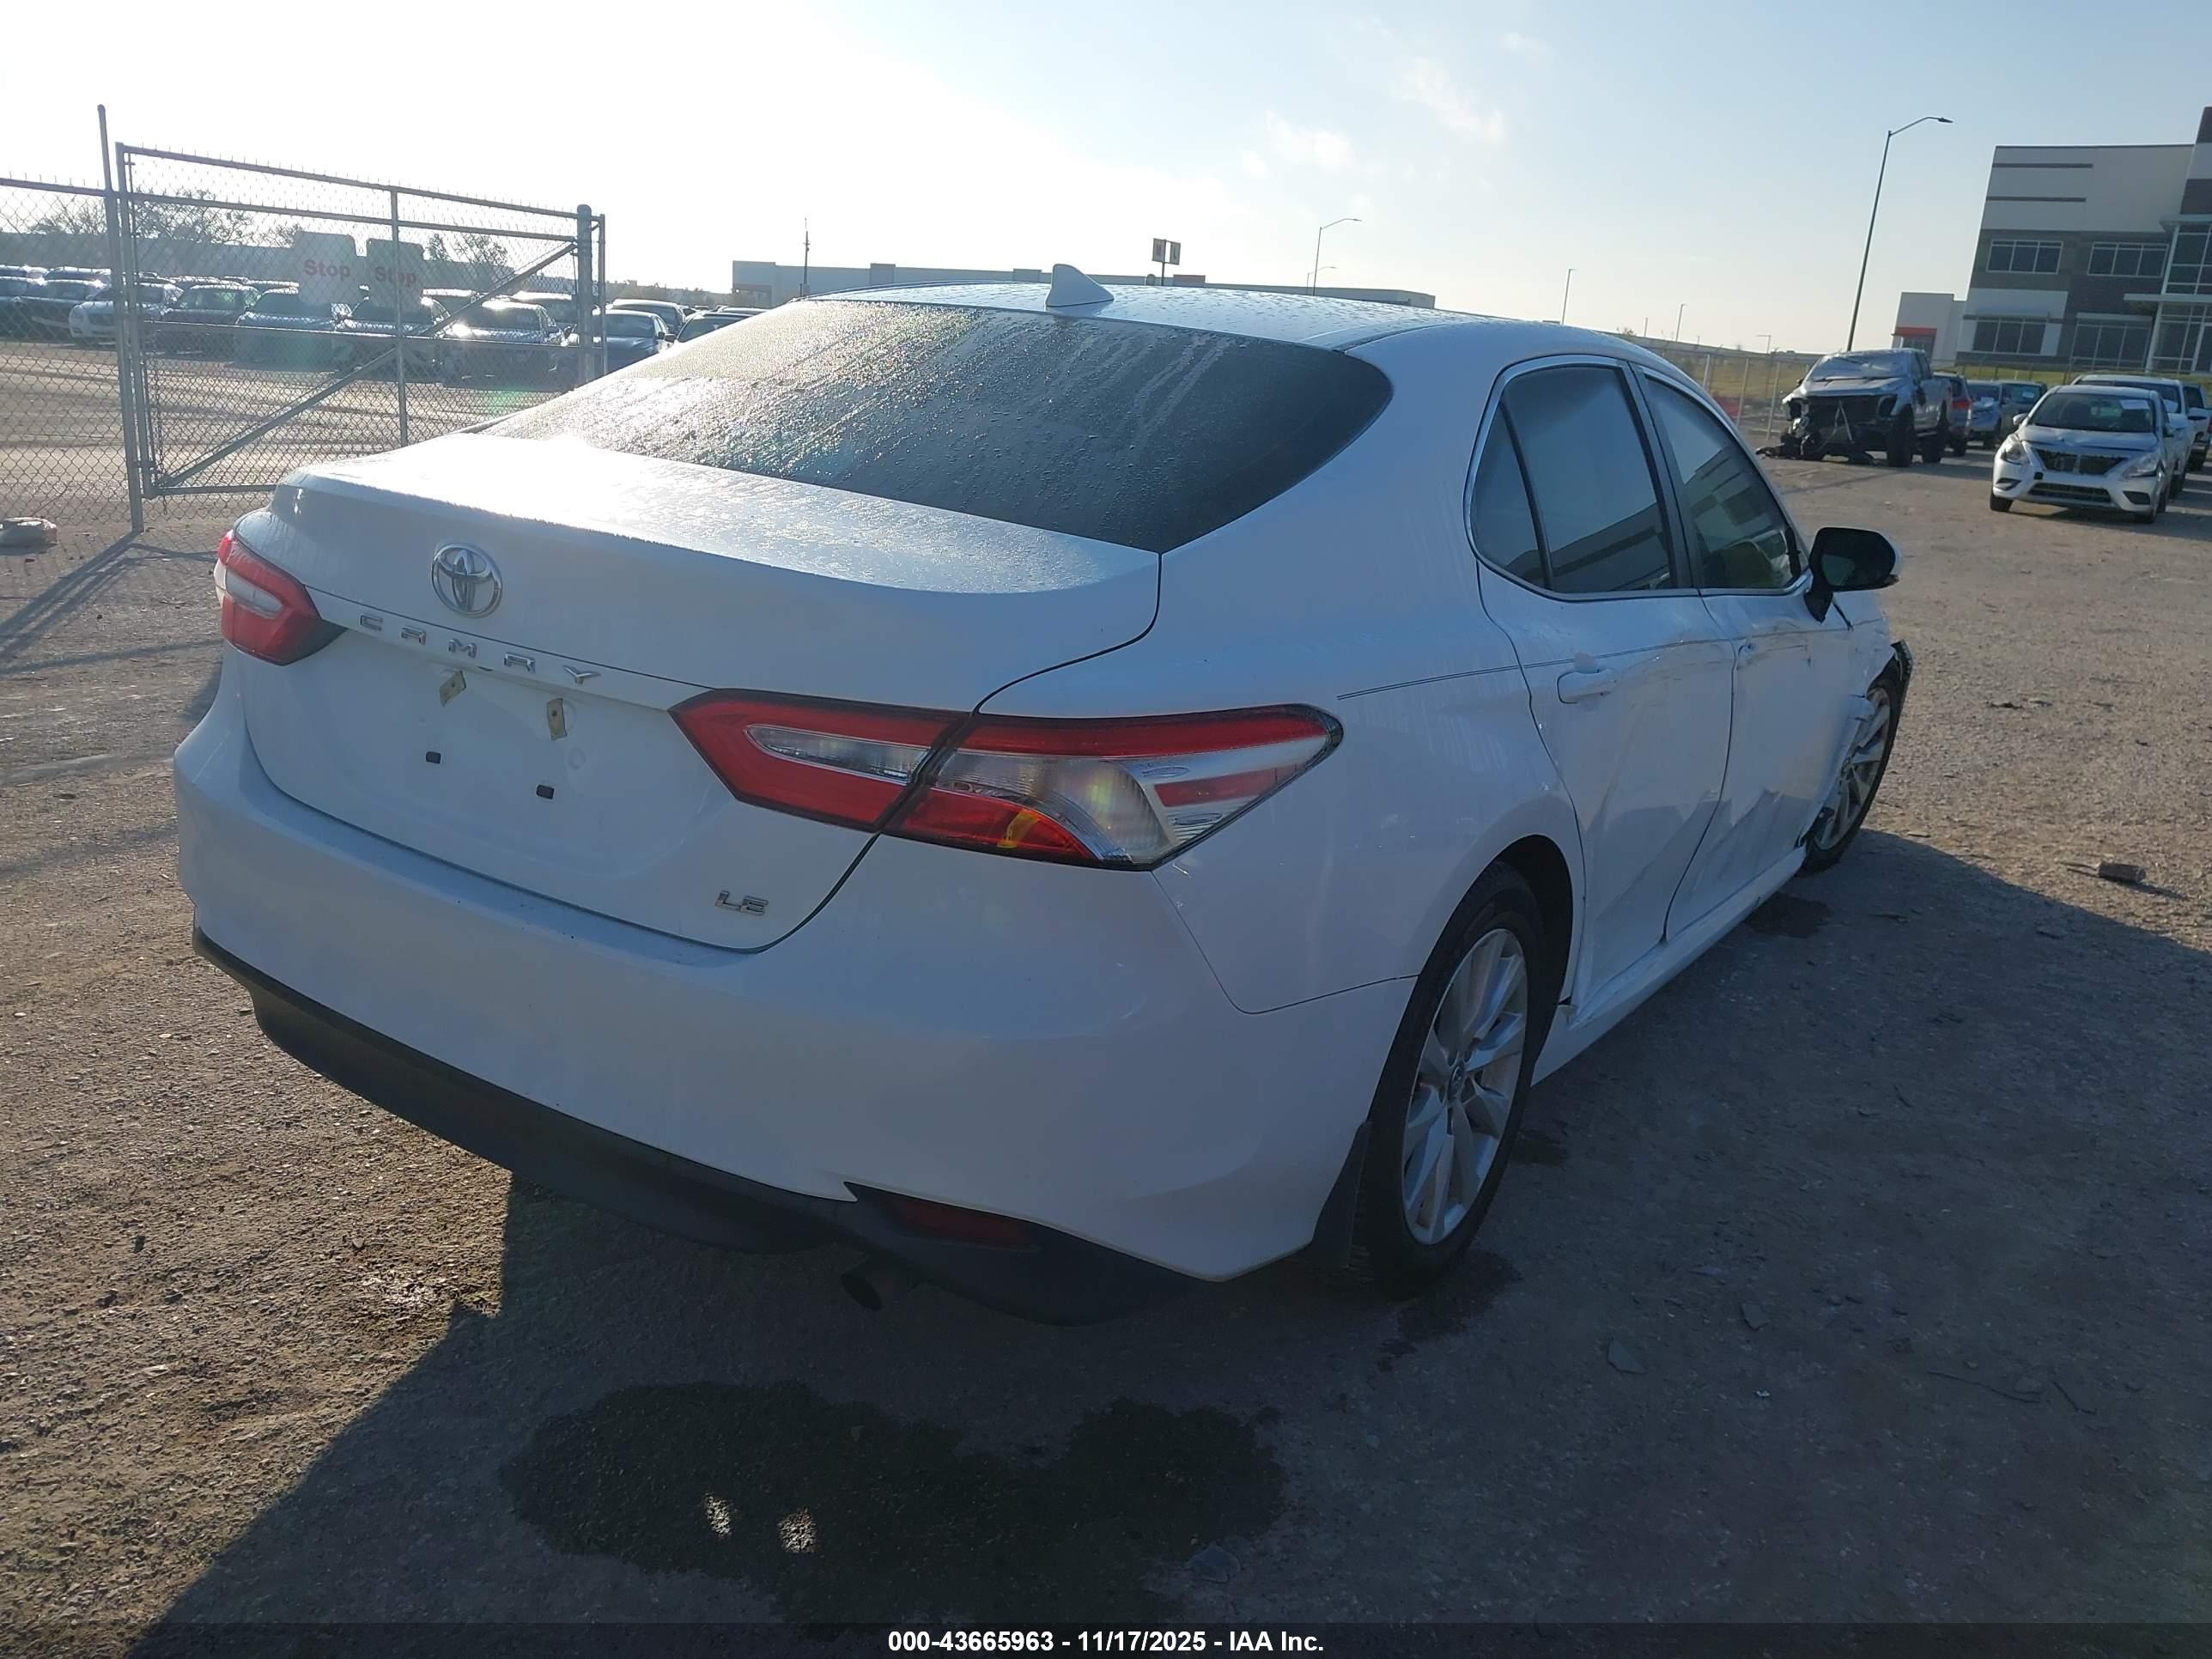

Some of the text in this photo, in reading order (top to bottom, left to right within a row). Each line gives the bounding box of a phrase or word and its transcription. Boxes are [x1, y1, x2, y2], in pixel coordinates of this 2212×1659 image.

[304, 259, 351, 281] Stop
[359, 614, 600, 685] CAMRY
[714, 889, 769, 917] LE
